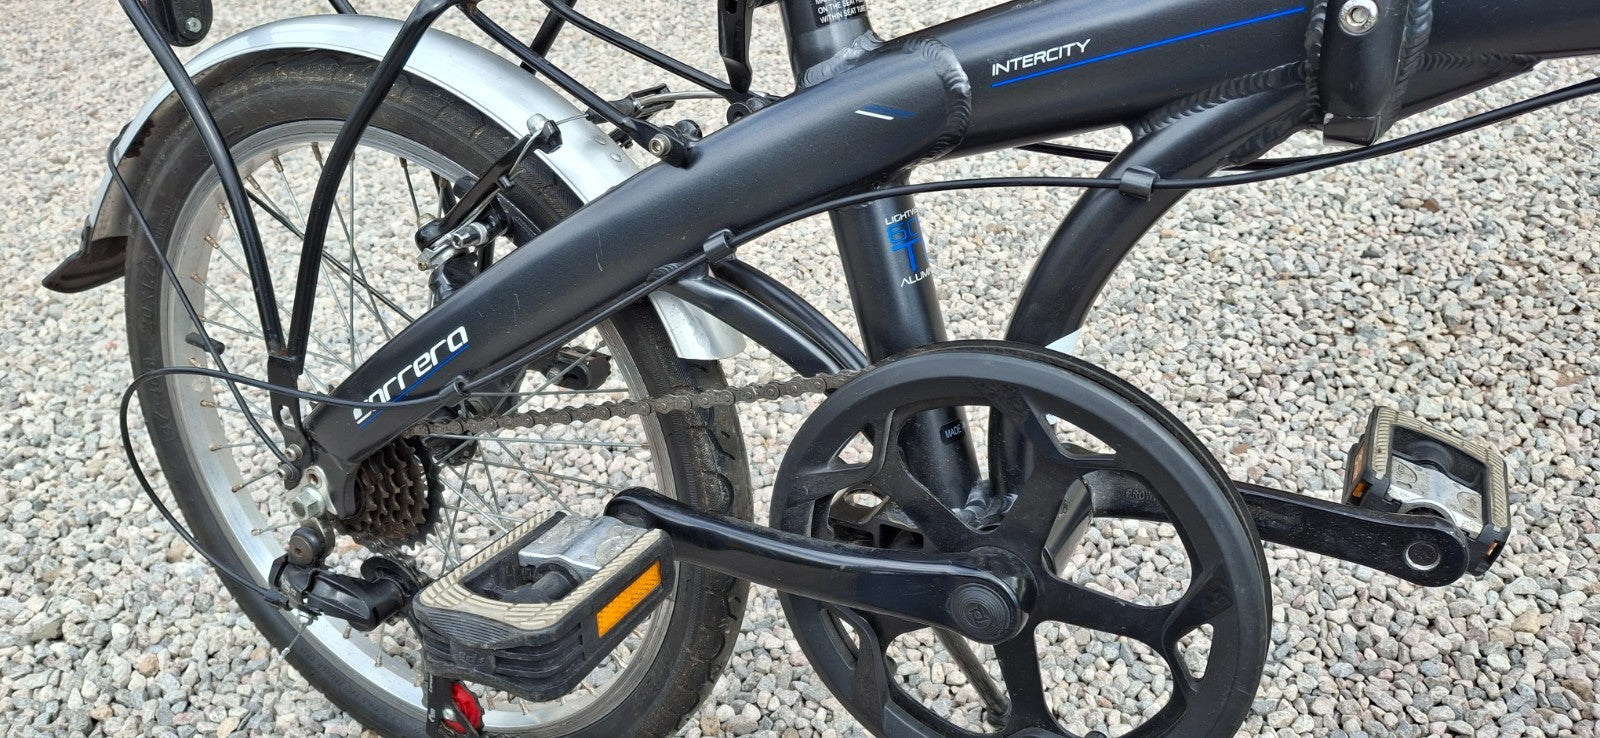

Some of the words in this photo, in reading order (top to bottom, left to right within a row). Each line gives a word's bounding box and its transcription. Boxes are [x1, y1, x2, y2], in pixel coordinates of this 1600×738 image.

[818, 5, 828, 14] ON
[828, 2, 842, 10] THE
[820, 12, 843, 23] WITHIN
[844, 7, 857, 16] SEAT
[992, 39, 1091, 76] INTERCITY
[944, 423, 962, 439] MADE
